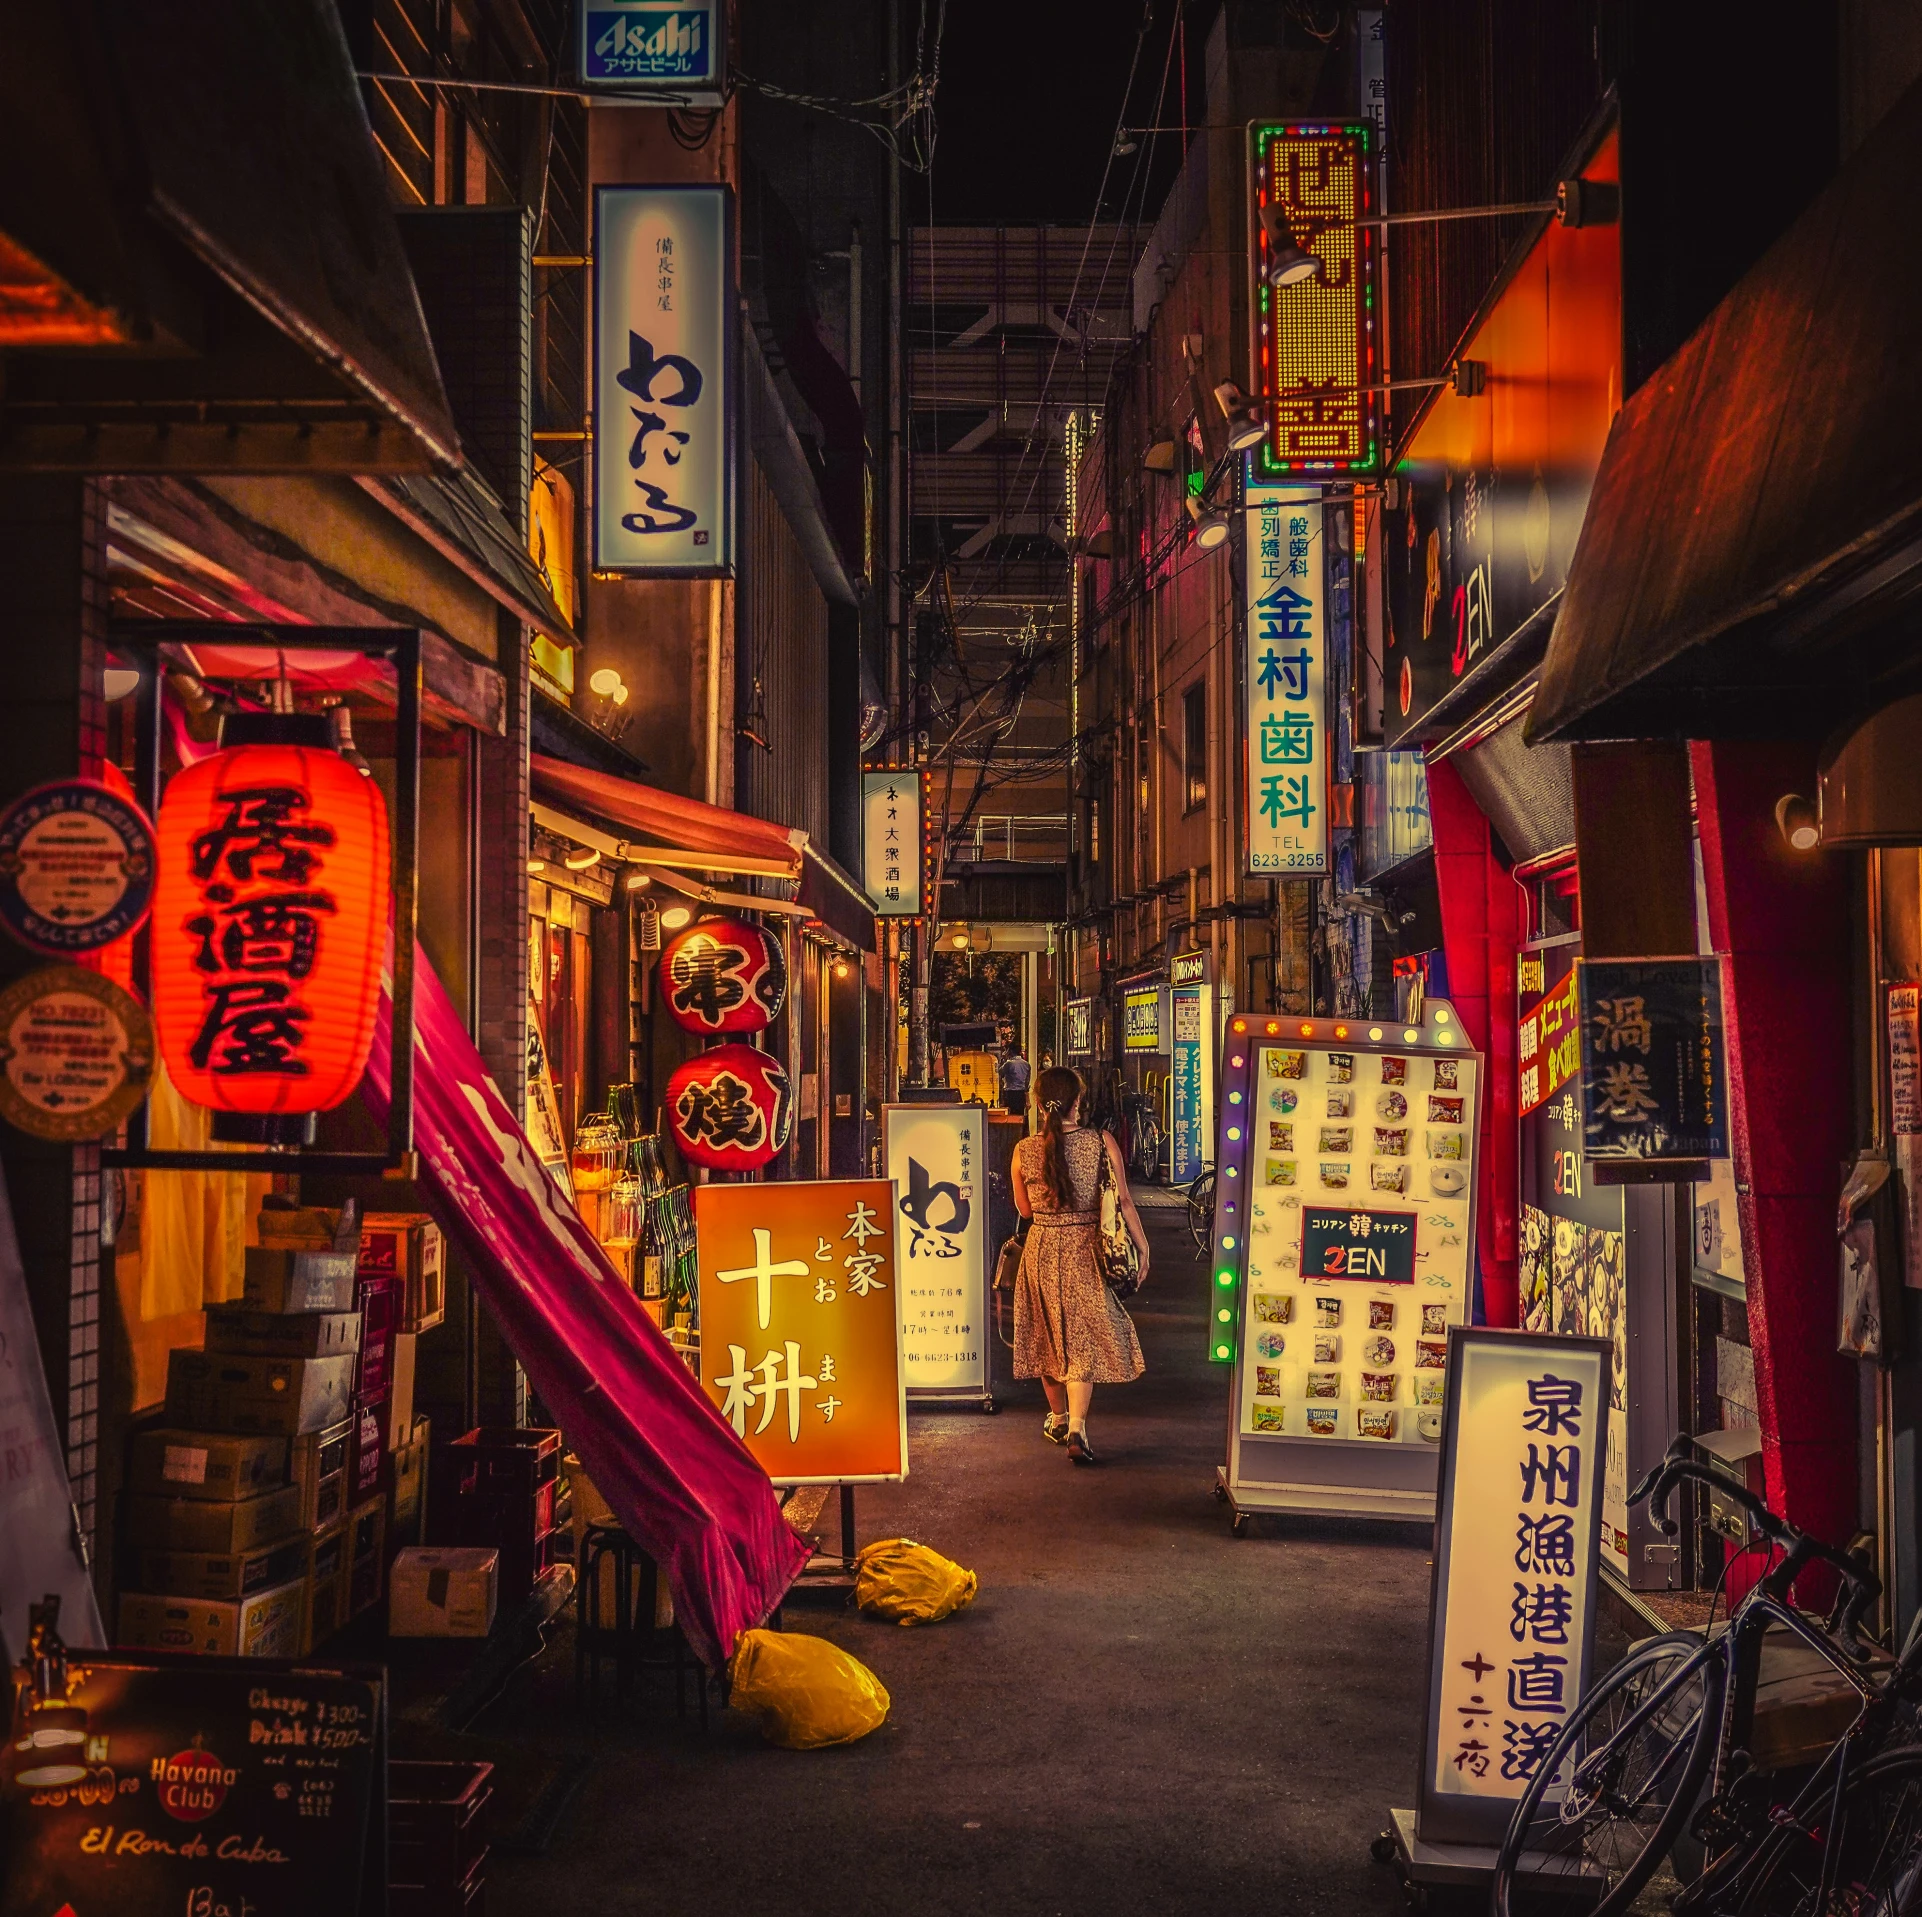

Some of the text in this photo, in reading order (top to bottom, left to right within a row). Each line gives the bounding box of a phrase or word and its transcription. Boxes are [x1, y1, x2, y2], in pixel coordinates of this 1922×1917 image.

[595, 13, 701, 57] Asahi
[604, 57, 692, 73] アサヒビール
[655, 237, 675, 312] 備長串屋
[616, 329, 704, 534] わたる
[1260, 497, 1280, 578] 歯列矯正
[1256, 585, 1316, 829] 金村歯科
[884, 786, 901, 901] ネオ大衆酒場
[1252, 853, 1324, 867] 623-3255
[1272, 836, 1304, 849] TEL
[186, 786, 336, 1077] 居酒屋
[671, 932, 750, 1028] 串
[1175, 1047, 1188, 1116] 電子マネー
[1593, 995, 1660, 1124] 渦巻
[959, 1128, 972, 1182] 備長串屋
[1175, 1119, 1189, 1175] 使えます
[1554, 1149, 1581, 1199] ZEN
[899, 1156, 971, 1259] わたる
[1311, 1214, 1409, 1237] コリアン 韓 キッチン
[814, 1236, 837, 1304] とお
[842, 1201, 888, 1297] 本家
[1323, 1245, 1386, 1276] ZEN
[815, 1353, 843, 1424] ます
[1501, 1373, 1584, 1784] 泉州漁港直送
[250, 1719, 308, 1746] Drink
[1453, 1652, 1495, 1779] 十六夜
[151, 1757, 237, 1787] Havana
[167, 1784, 215, 1810] Club
[80, 1826, 291, 1864] El Ron de Cuba
